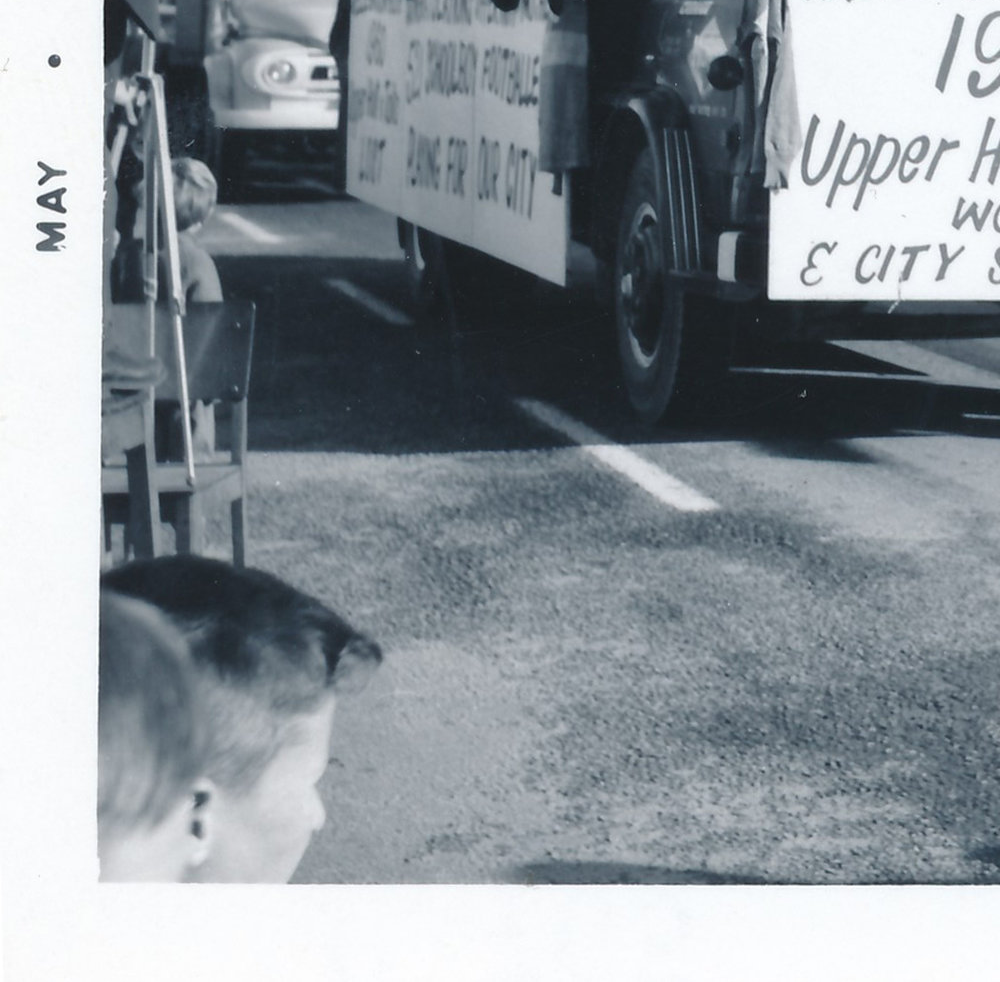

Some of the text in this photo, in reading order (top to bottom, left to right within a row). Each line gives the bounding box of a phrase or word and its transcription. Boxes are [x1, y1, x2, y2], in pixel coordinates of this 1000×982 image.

[477, 135, 501, 204] OUR
[504, 142, 539, 221] CITY
[801, 114, 960, 211] Upper
[856, 243, 967, 284] CITY
